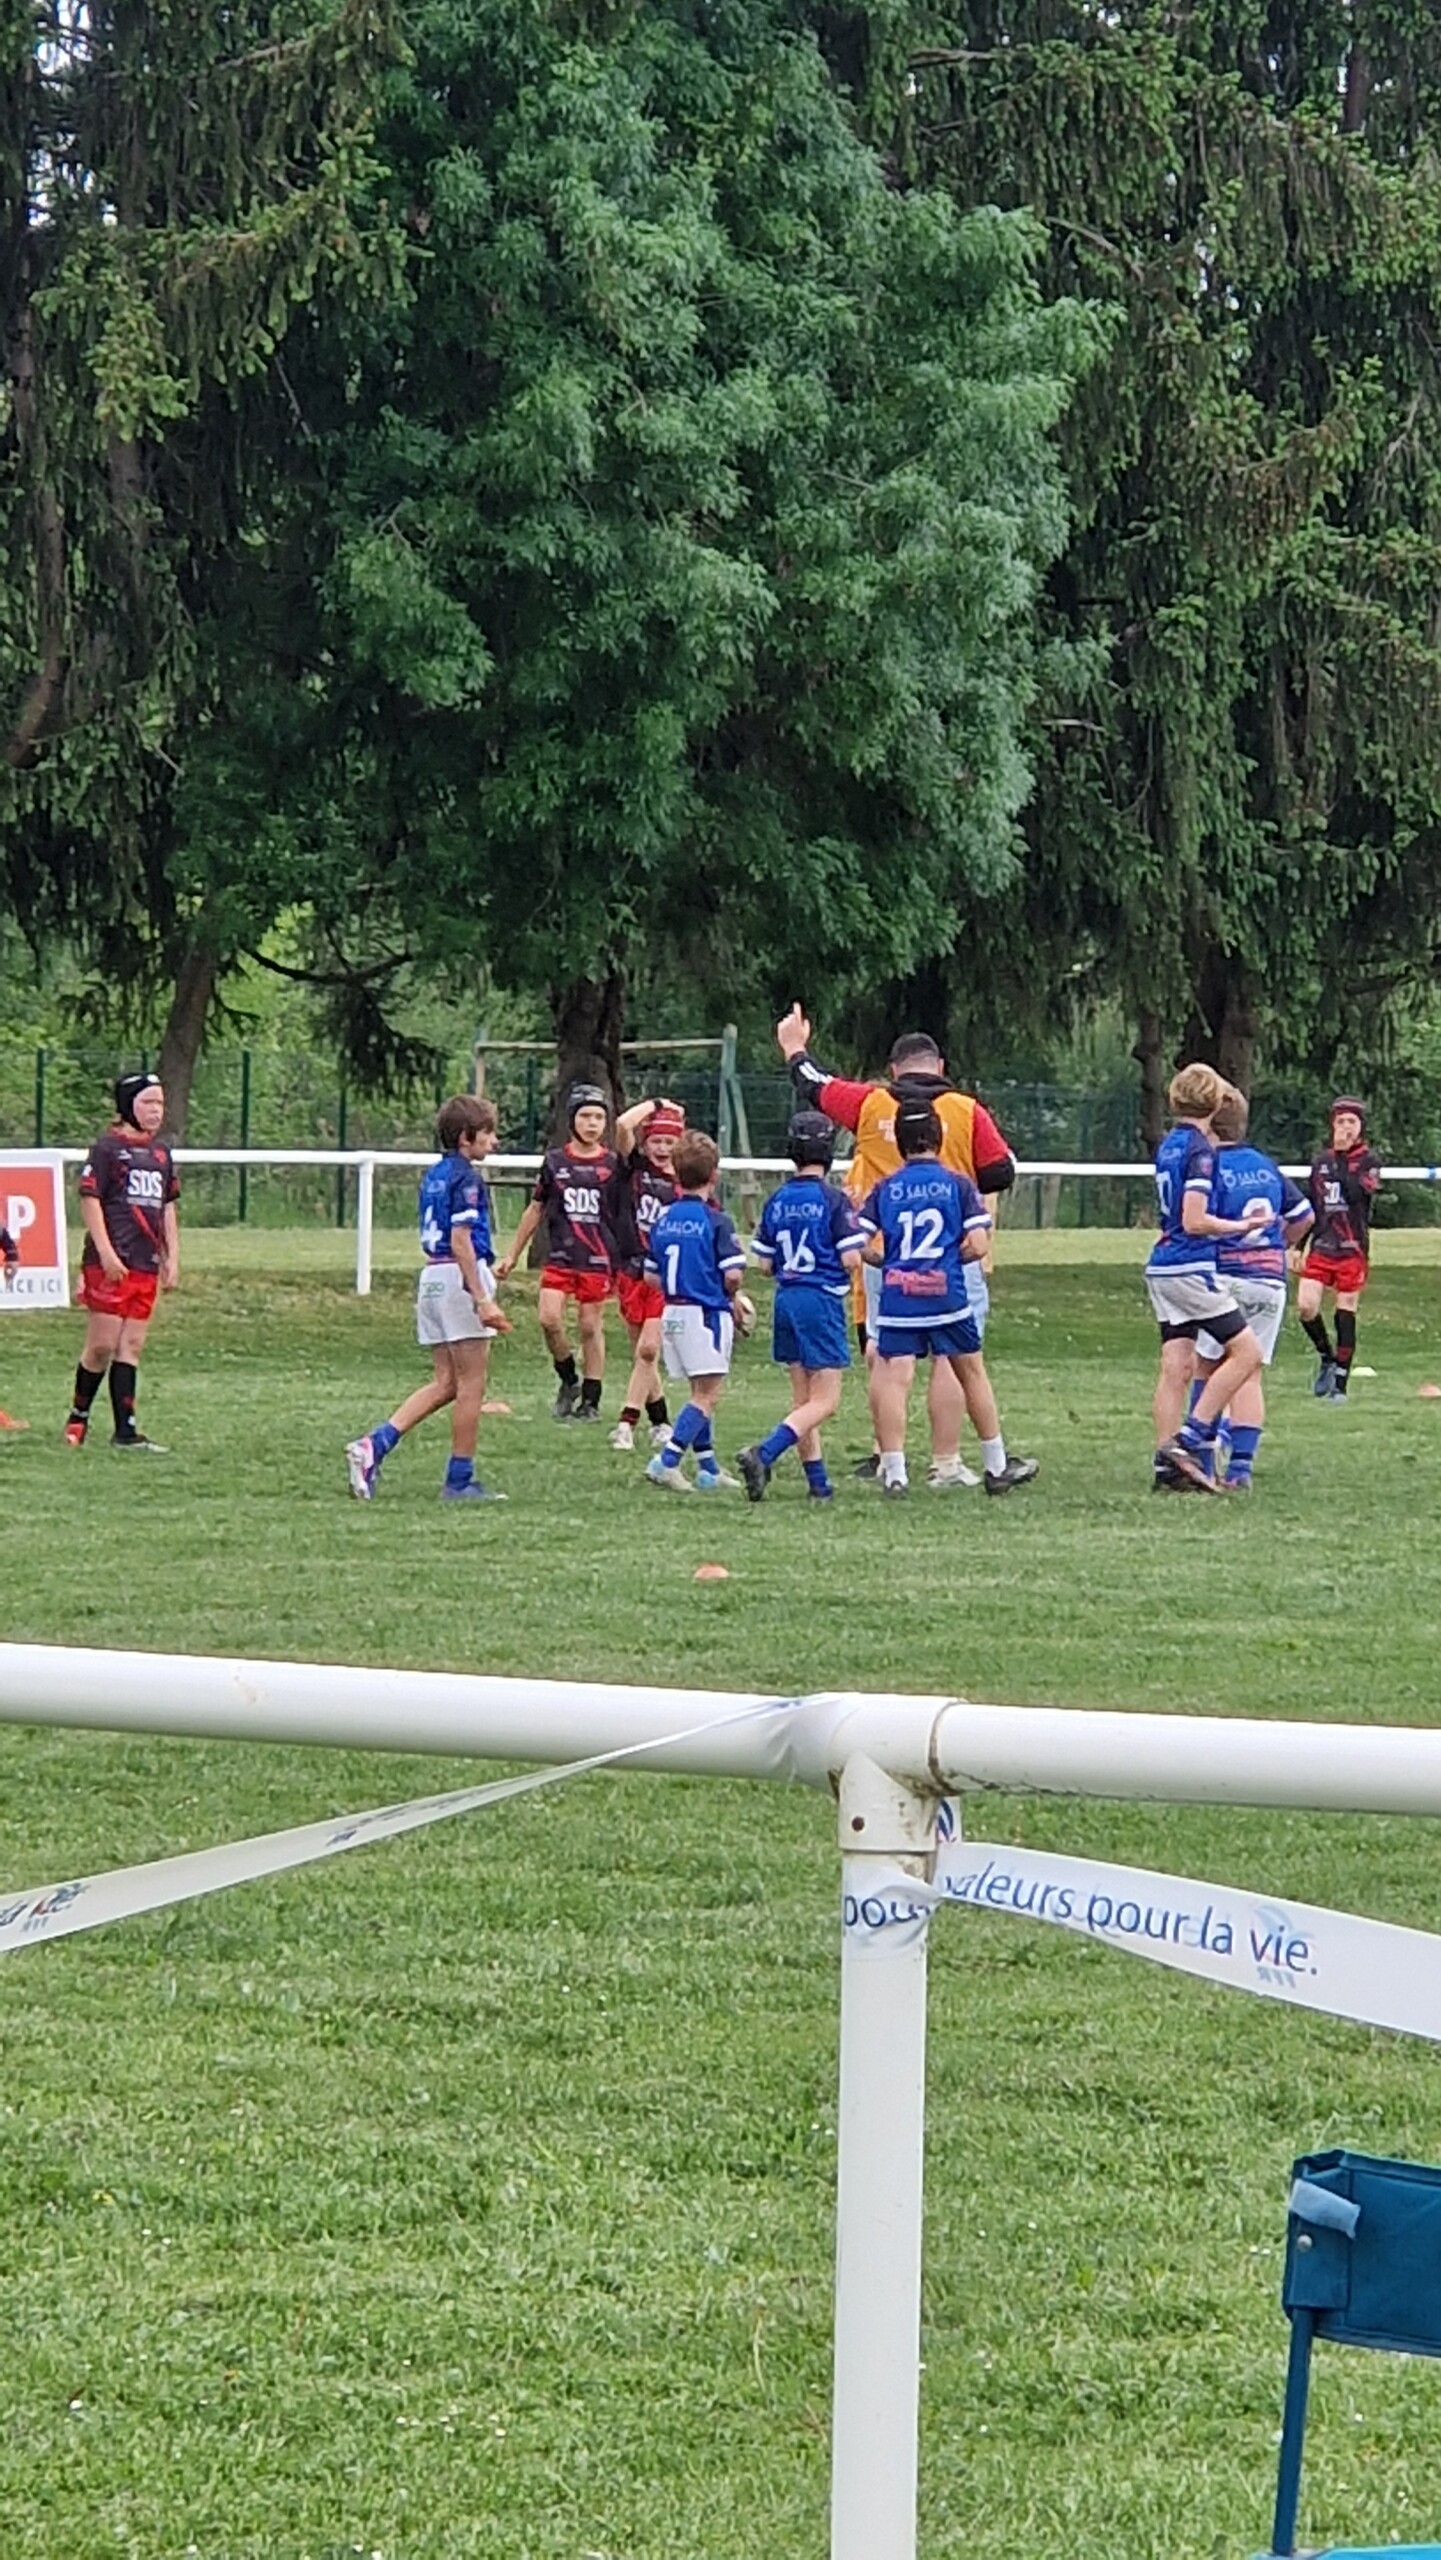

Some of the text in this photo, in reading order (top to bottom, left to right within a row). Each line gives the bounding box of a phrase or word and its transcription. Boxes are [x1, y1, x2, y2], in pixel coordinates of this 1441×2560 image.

[127, 1168, 163, 1198] SDS
[563, 1187, 600, 1214] SDS
[421, 1204, 443, 1252] 4
[775, 1227, 816, 1273] 16
[897, 1208, 945, 1260] 12
[40, 1279, 61, 1293] ICI
[664, 1244, 680, 1295] 1
[1086, 1893, 1191, 1943] pour
[1201, 1905, 1233, 1956] la
[1250, 1925, 1318, 1976] vie.
